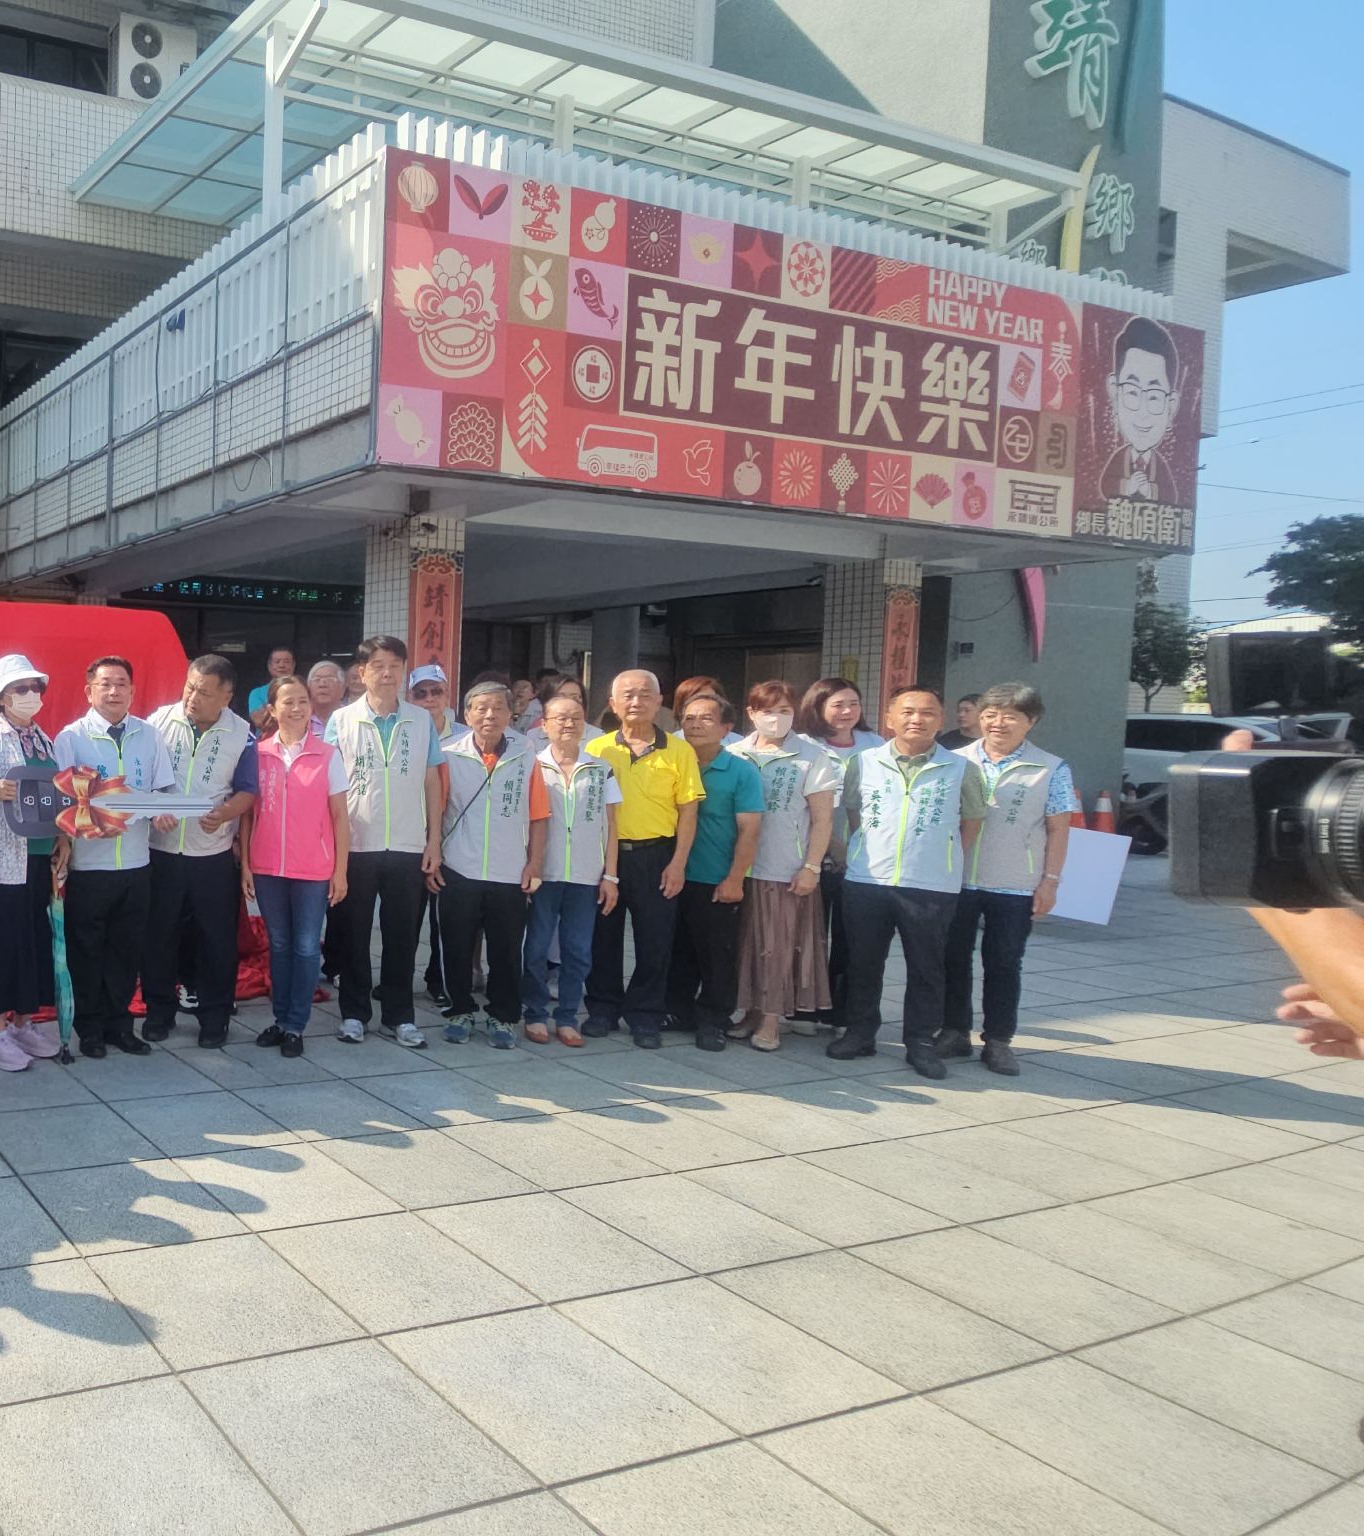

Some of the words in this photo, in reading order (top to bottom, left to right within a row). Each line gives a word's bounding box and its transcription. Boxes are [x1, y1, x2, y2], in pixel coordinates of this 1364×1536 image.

[929, 269, 1007, 308] HAPPY
[927, 297, 978, 331] NEW
[984, 306, 1044, 344] YEAR
[633, 288, 992, 451] 新年快樂
[1076, 510, 1106, 536] 鄉長
